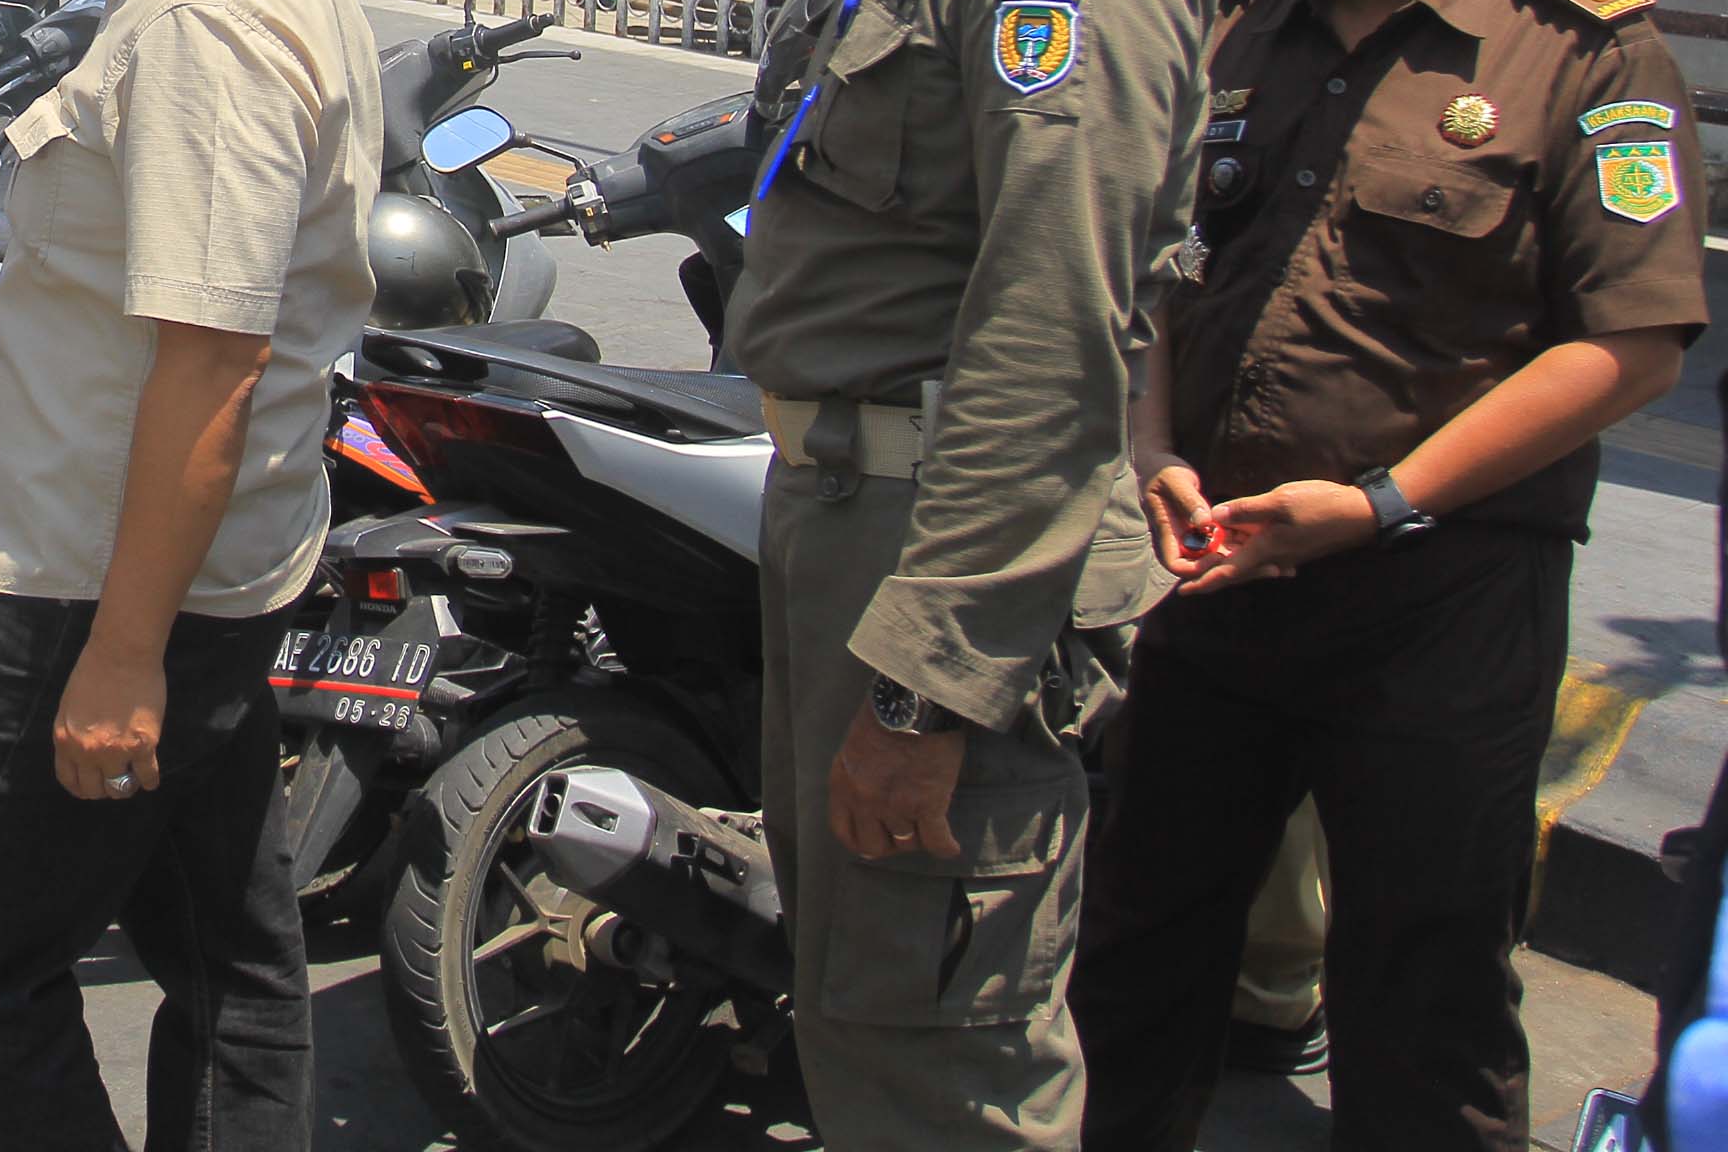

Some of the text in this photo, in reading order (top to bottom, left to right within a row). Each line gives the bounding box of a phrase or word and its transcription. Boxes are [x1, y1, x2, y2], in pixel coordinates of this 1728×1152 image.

[274, 631, 431, 684] AE 2686 ID
